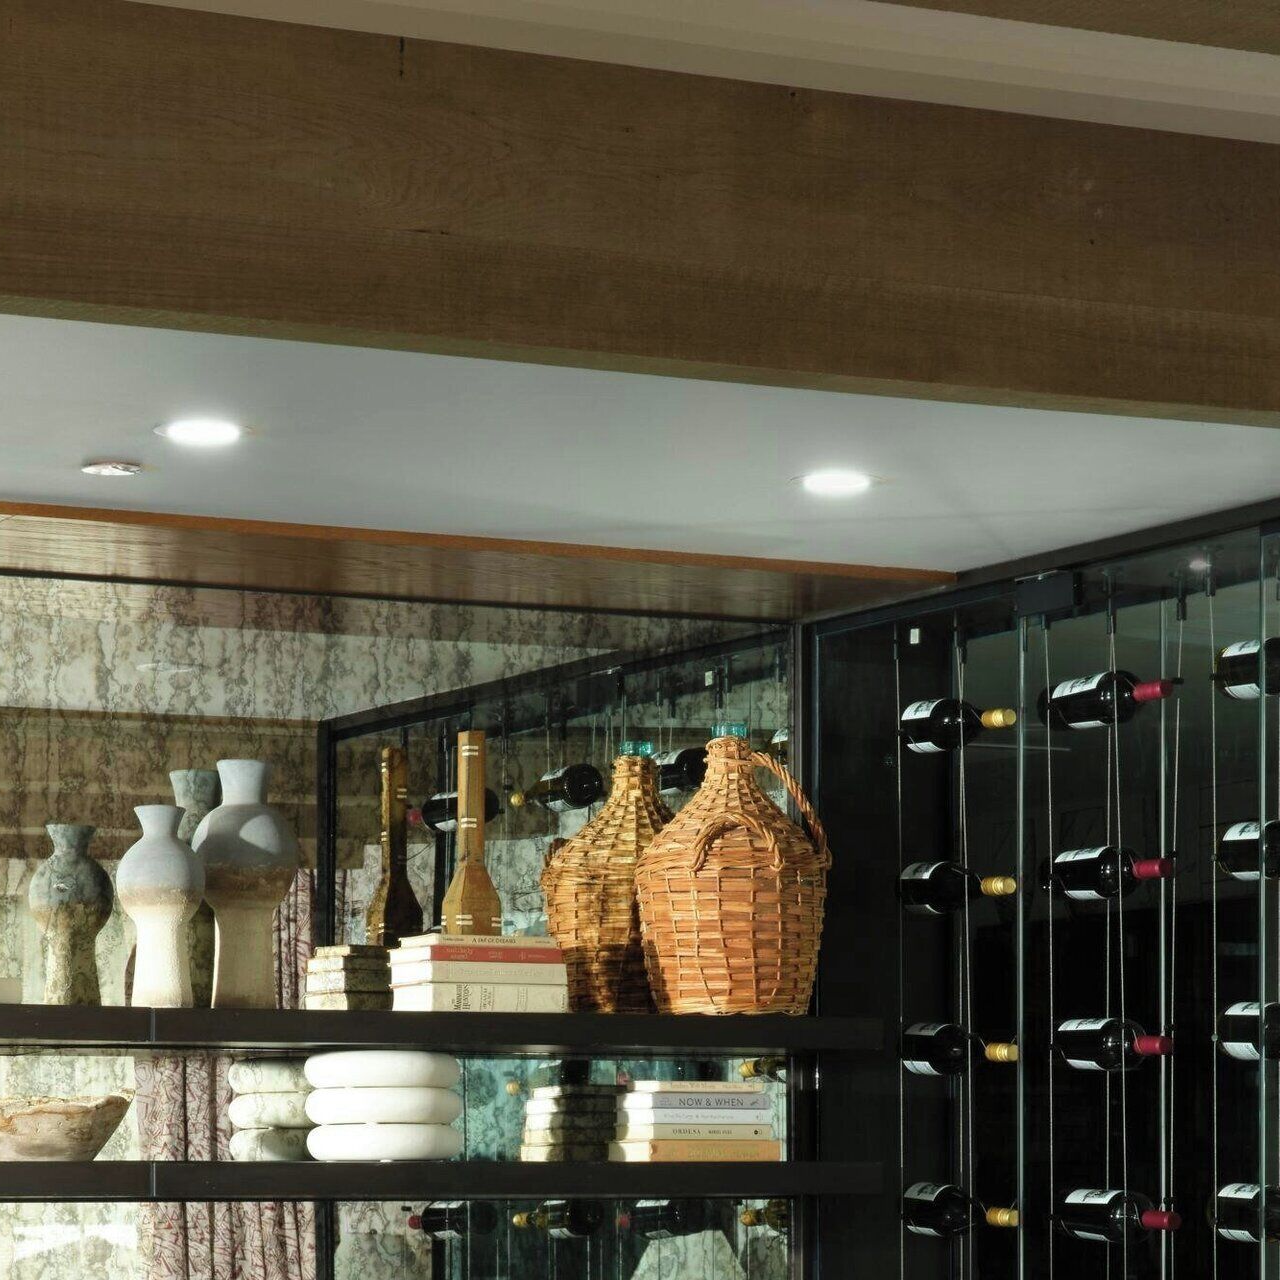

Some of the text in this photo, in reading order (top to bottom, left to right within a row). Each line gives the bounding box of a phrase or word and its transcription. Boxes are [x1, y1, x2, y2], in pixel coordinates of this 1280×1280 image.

[679, 1098, 744, 1107] NOW & WHEN
